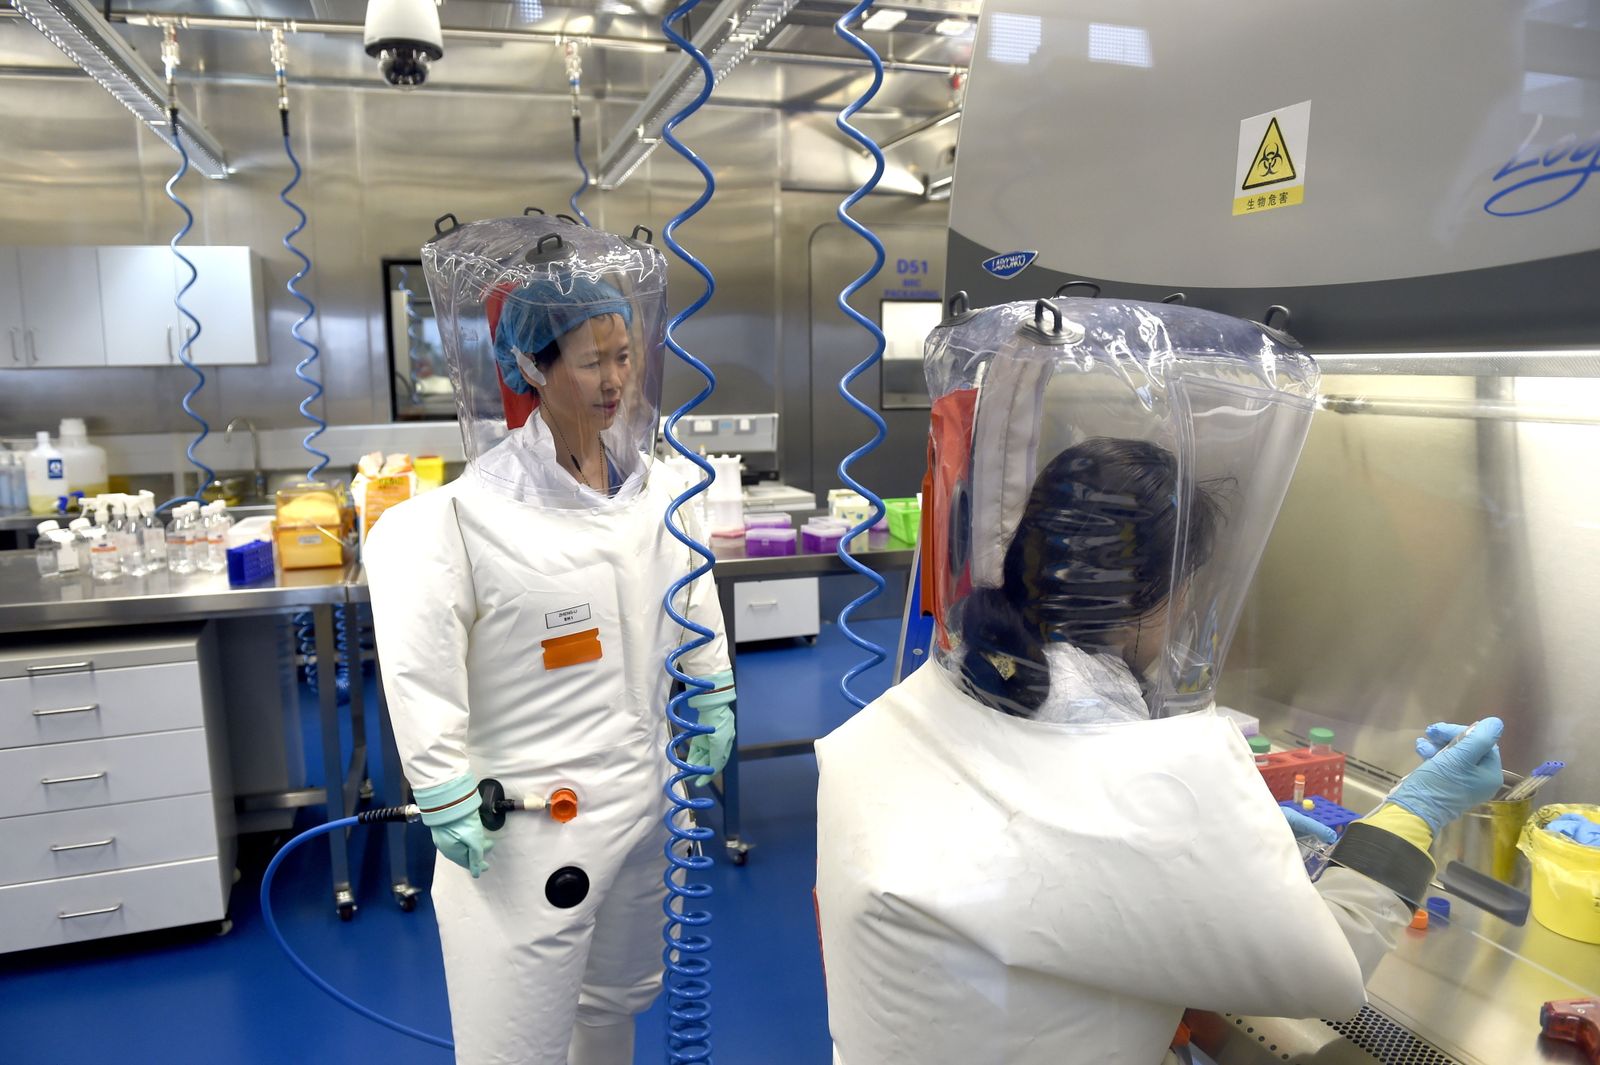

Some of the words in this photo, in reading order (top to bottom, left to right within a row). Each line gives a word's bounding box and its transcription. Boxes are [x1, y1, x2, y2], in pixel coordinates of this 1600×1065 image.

[1246, 192, 1289, 211] 生物危害
[896, 258, 929, 274] D51
